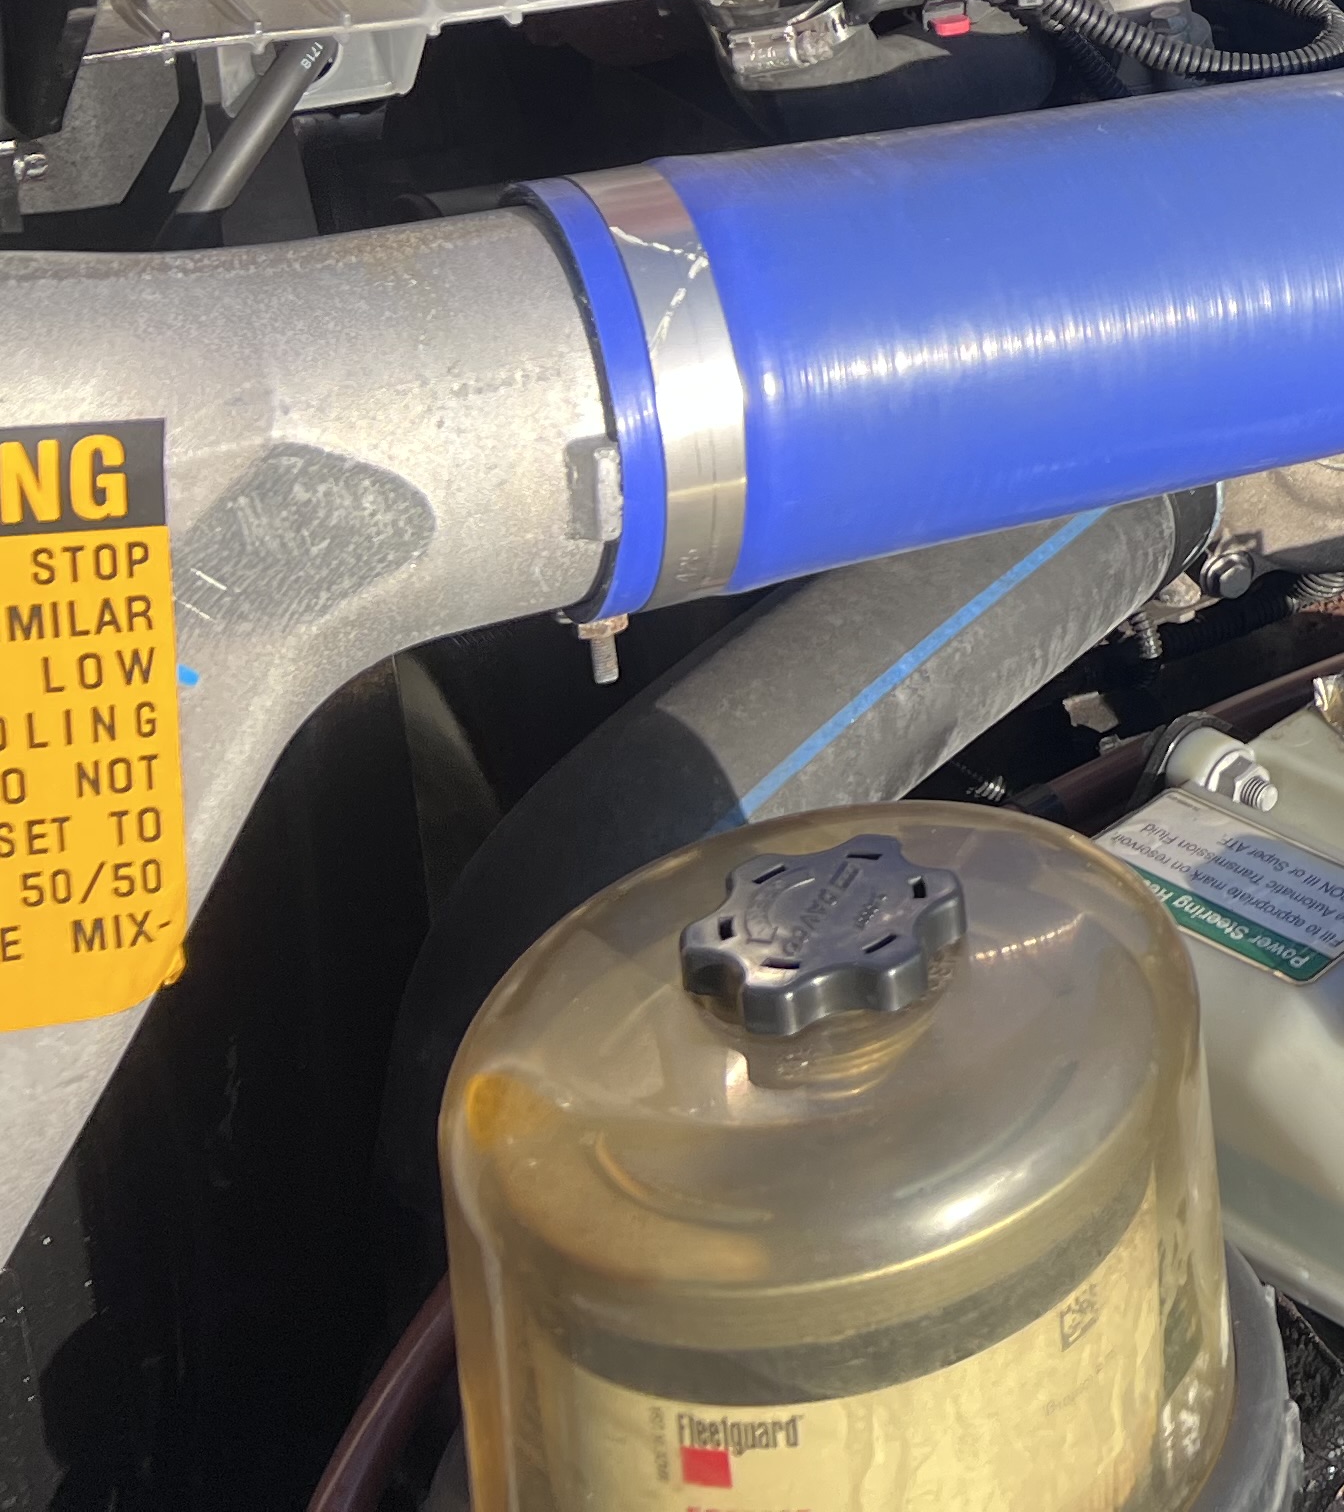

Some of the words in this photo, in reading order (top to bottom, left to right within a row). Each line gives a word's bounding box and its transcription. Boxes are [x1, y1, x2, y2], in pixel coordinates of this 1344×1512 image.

[300, 41, 324, 70] 1718
[0, 433, 127, 525] NG
[32, 540, 151, 585] STOP
[6, 593, 154, 644] MILAR
[44, 646, 156, 693] LOW
[77, 753, 160, 799] NOT
[0, 815, 71, 859] SET
[109, 806, 162, 849] TO
[1140, 823, 1180, 845] Fluid
[21, 858, 162, 907] 50/50
[1170, 859, 1191, 873] on
[1178, 839, 1264, 885] Transmission
[1190, 869, 1228, 890] mark
[1247, 849, 1290, 873] Super
[1288, 867, 1306, 878] or
[1172, 894, 1250, 940] Steering
[1227, 887, 1306, 928] appropriate
[1266, 879, 1336, 918] Automatic
[0, 925, 23, 962] E
[71, 914, 172, 954] MIX-
[1250, 933, 1310, 968] Power
[1305, 924, 1323, 940] to
[1320, 932, 1344, 948] Fill
[676, 1412, 801, 1457] Fleetguard
